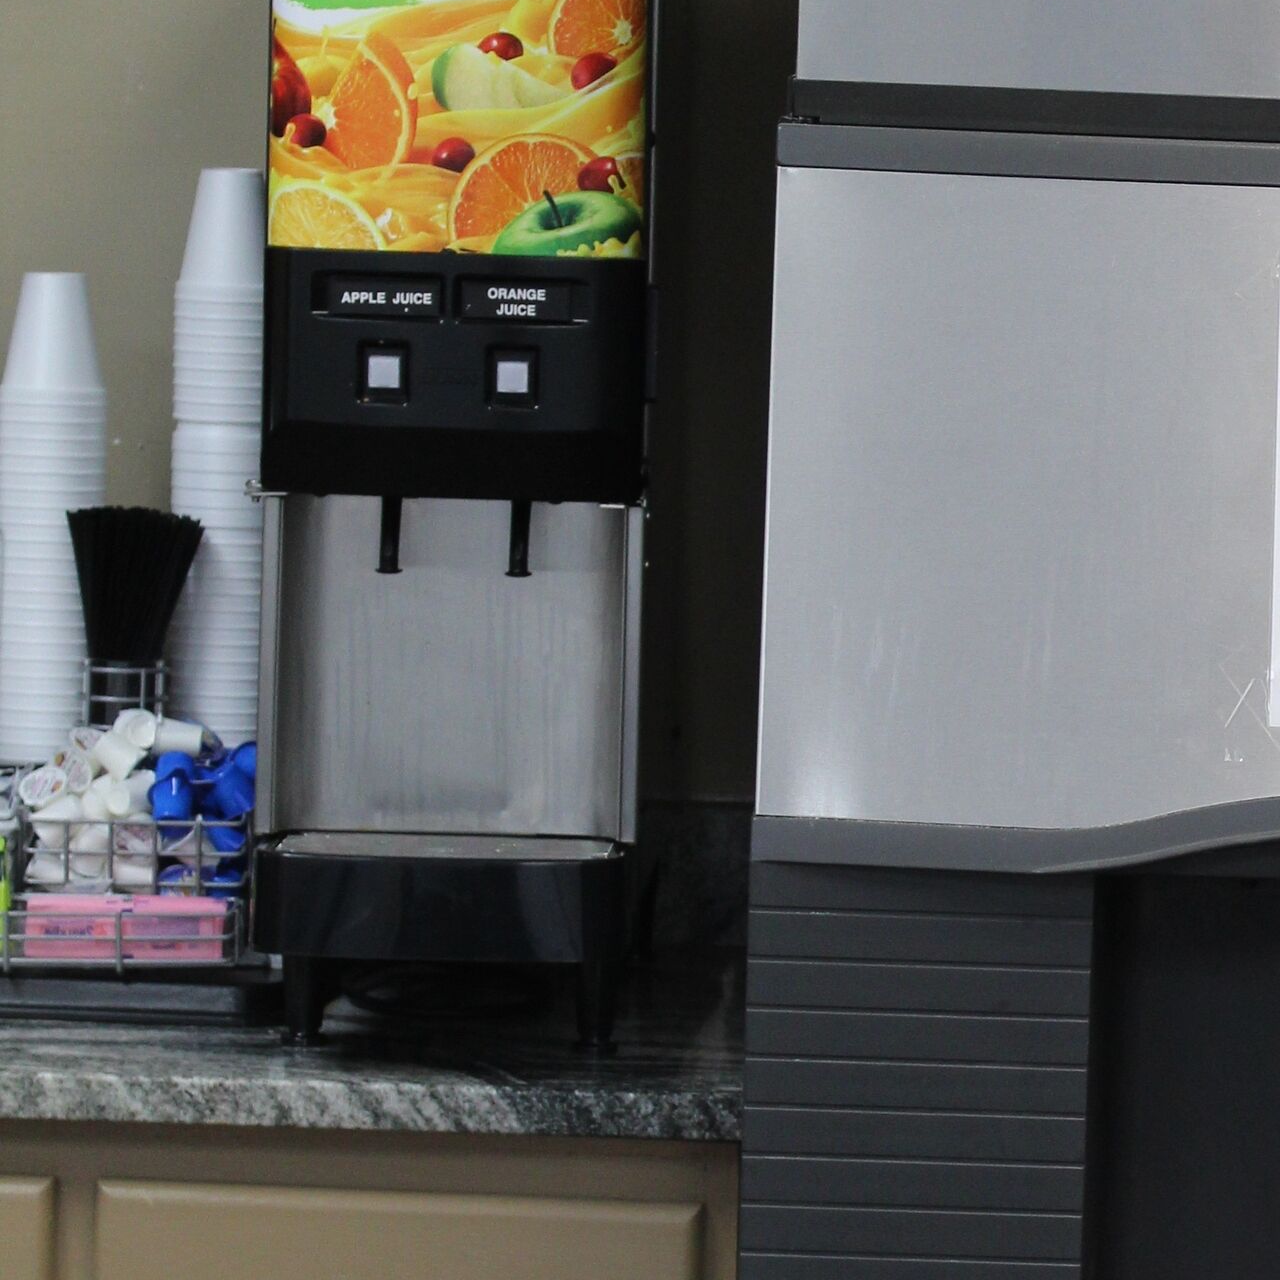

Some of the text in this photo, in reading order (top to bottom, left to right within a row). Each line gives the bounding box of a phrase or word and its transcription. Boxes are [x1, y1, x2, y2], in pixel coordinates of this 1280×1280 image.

[341, 291, 433, 305] APPLE JUICE
[487, 287, 547, 301] ORANGE
[496, 304, 537, 316] JUICE
